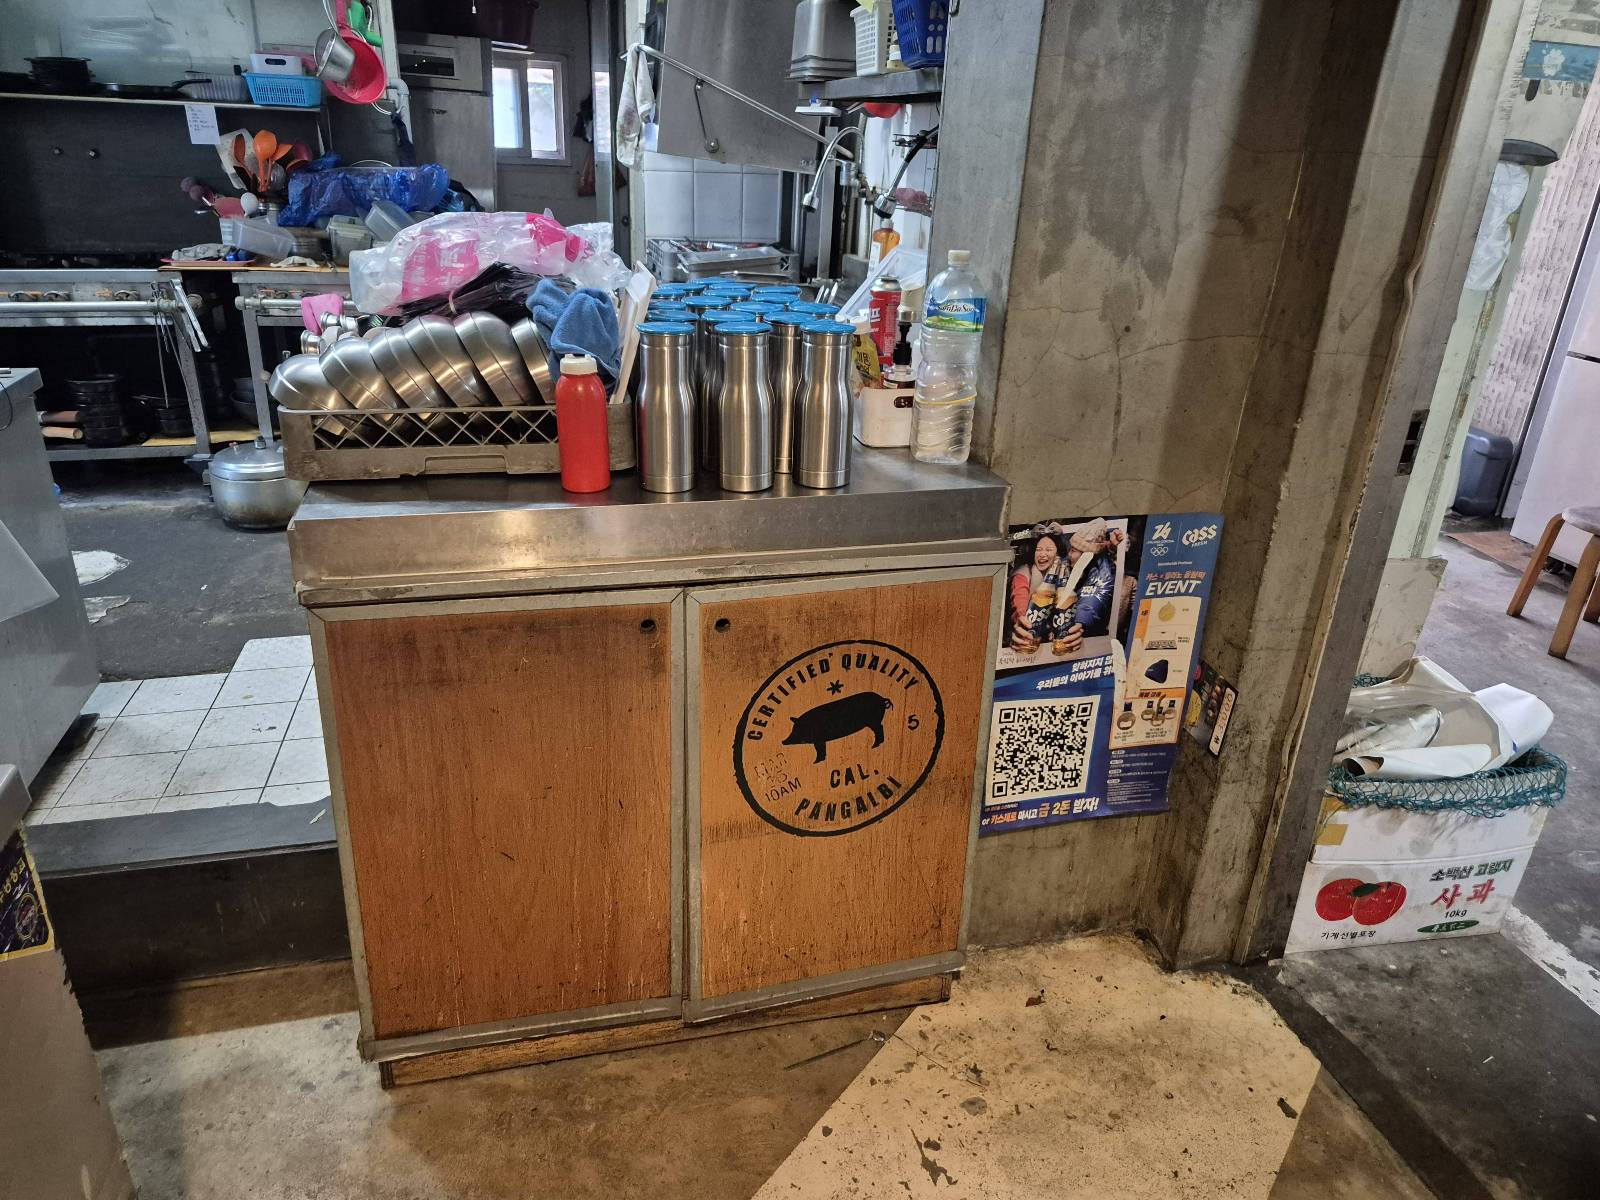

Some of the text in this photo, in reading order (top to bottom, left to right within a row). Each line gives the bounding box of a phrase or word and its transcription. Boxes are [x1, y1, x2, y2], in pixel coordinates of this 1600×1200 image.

[1145, 580, 1202, 596] EVENT
[1036, 674, 1069, 691] 우리들의
[1070, 667, 1102, 682] 이야기를
[747, 652, 919, 740] CERTIFIED QUALITY
[830, 763, 880, 788] CAL.
[765, 777, 802, 802] 10AM
[794, 775, 902, 822] PANGALBI
[1018, 808, 1038, 820] 마시고
[1039, 802, 1050, 818] 금
[1051, 800, 1071, 815] 2돈
[1072, 796, 1100, 814] 받자!
[1429, 858, 1514, 882] 소백산 고랭지
[1444, 908, 1468, 919] 10kg
